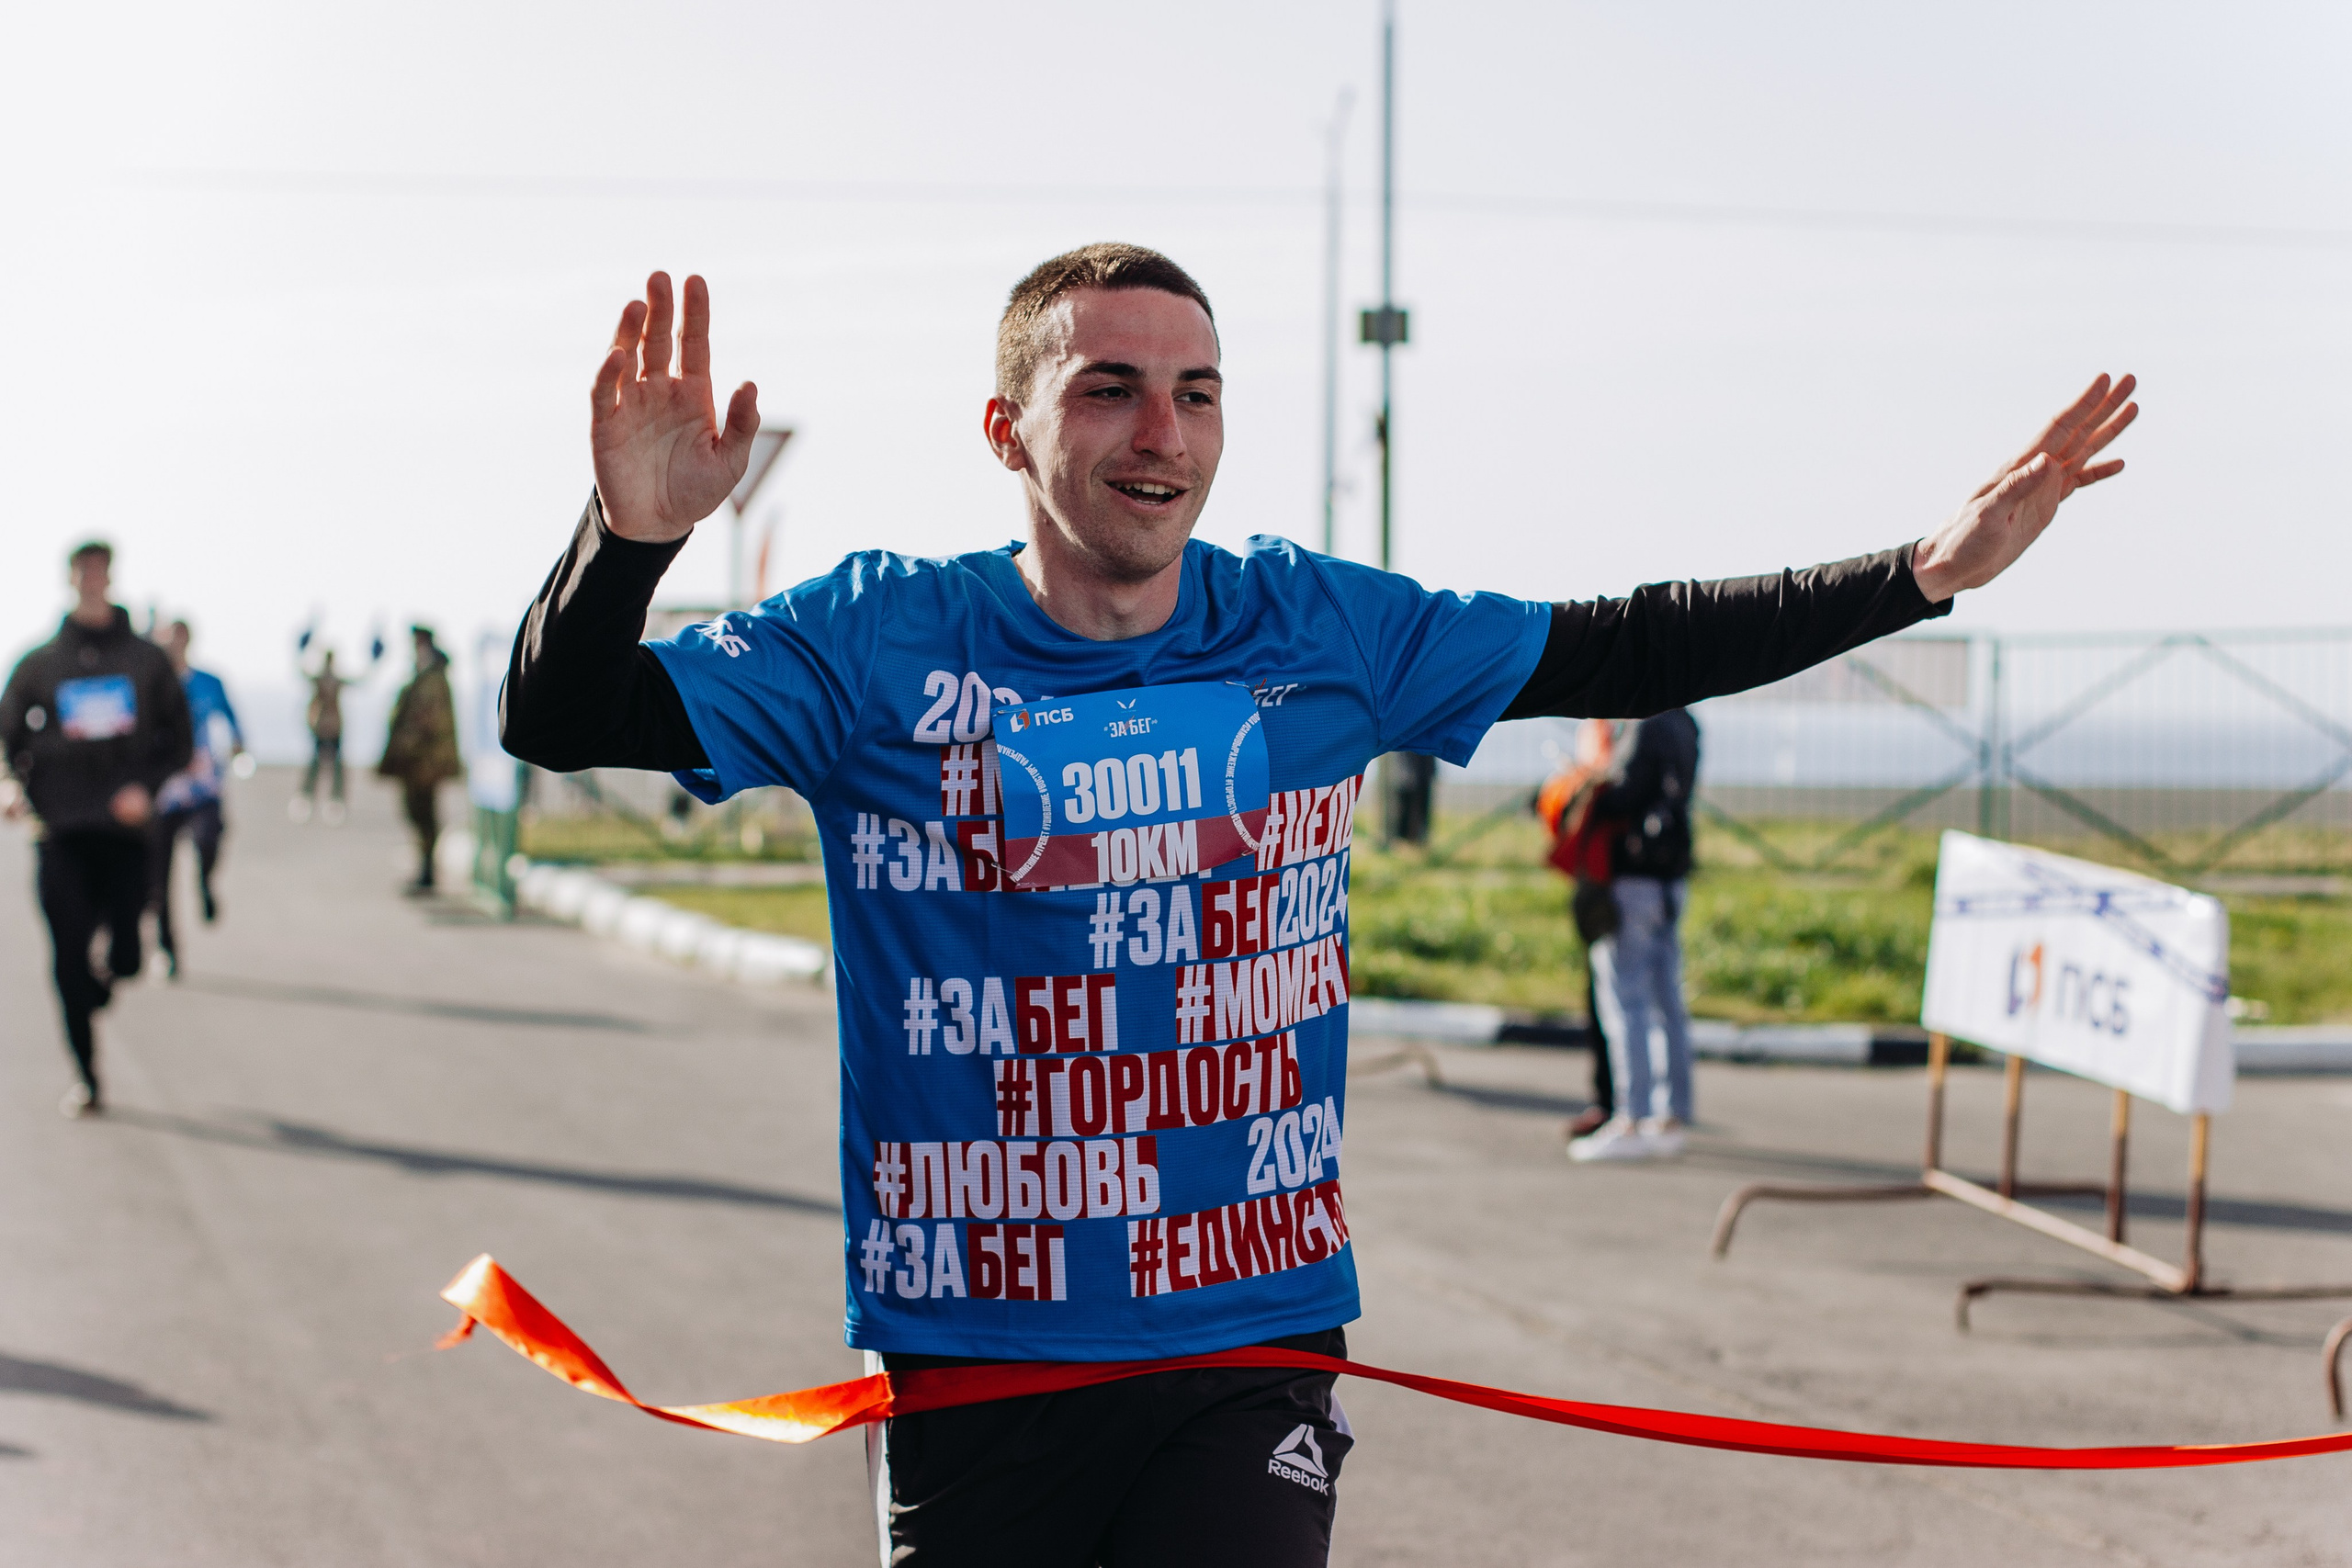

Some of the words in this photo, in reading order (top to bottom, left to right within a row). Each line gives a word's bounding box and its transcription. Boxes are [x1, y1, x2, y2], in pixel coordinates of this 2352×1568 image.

[913, 670, 1054, 743] 20
[1035, 707, 1074, 727] ПСБ
[1024, 763, 1047, 794] #ВОСТОРГ
[1062, 747, 1202, 824] 30011
[1225, 779, 1238, 815] #ГОРДОСТЬ
[851, 812, 1050, 892] #ЗАБ
[903, 973, 1116, 1055] #ЗАБЕГ
[1177, 931, 1349, 1044] #МОМЕН
[2056, 957, 2131, 1036] ПСБ
[996, 1031, 1303, 1137] #ГОРДОСТЬ
[874, 1134, 1160, 1221] #ЛЮБОВЬ
[1247, 1096, 1341, 1196] 2024
[860, 1218, 1067, 1302] #ЗАБЕГ
[1130, 1179, 1350, 1298] #ЕДИНСТ
[1268, 1459, 1329, 1496] Reebok
